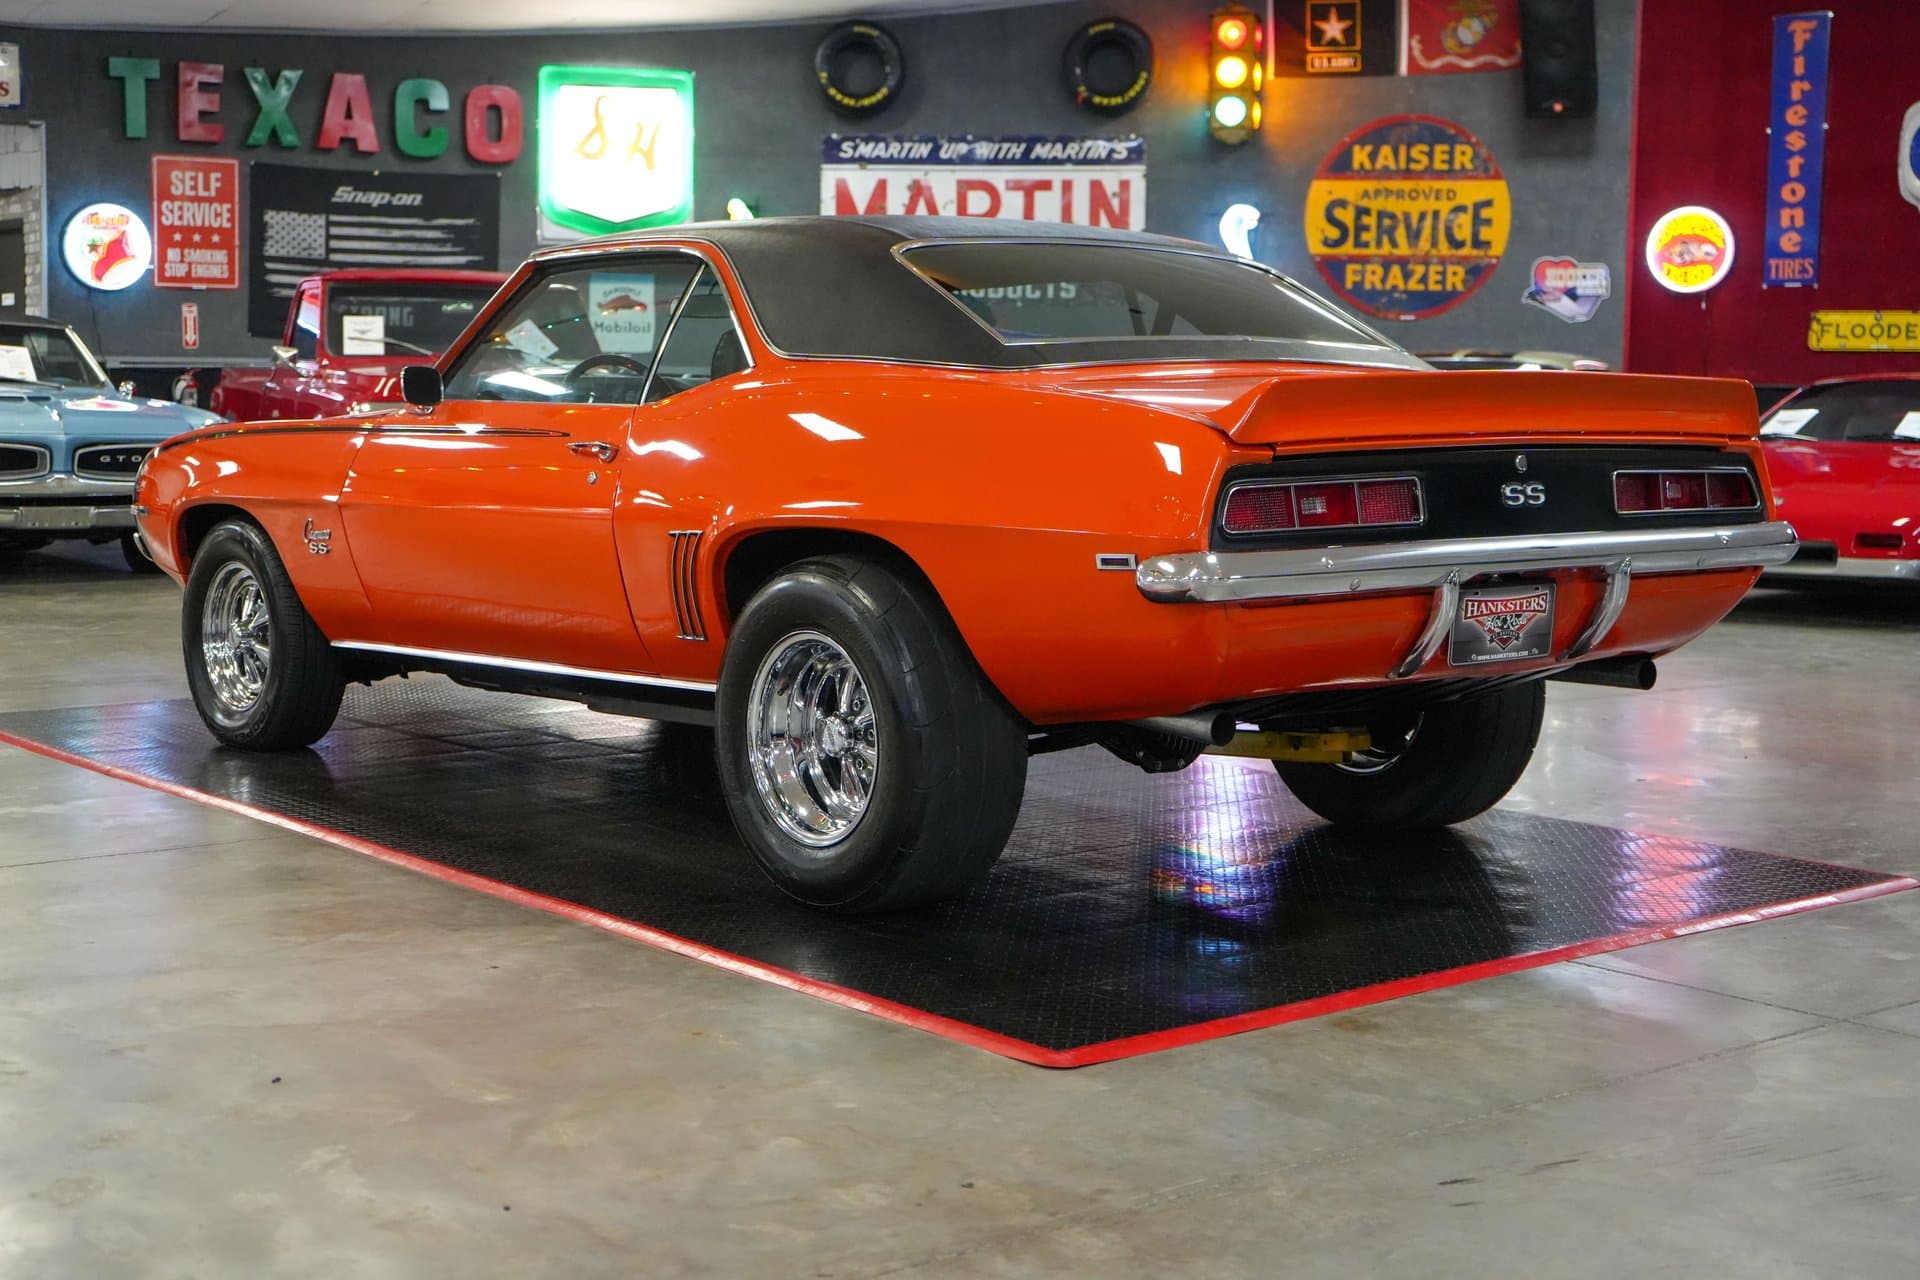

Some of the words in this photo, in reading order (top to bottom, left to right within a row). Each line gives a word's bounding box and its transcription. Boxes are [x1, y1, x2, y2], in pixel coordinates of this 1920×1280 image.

[108, 56, 523, 163] TEXACO
[1779, 20, 1818, 253] Firestone
[1351, 143, 1474, 171] KAISER
[170, 170, 222, 197] SELF
[1360, 187, 1457, 201] APPROVED
[331, 186, 424, 208] Snap-on
[161, 200, 232, 228] SERVICE
[1321, 197, 1495, 250] SERVICE
[167, 247, 181, 263] NO
[184, 248, 228, 264] SMOKING
[164, 263, 188, 278] STOP
[191, 264, 229, 279] ENGINES
[1344, 262, 1467, 292] FRAZER
[1768, 258, 1815, 280] TIRES
[594, 320, 651, 333] Mobiloil
[100, 455, 142, 463] GTO
[1502, 484, 1546, 506] SS
[309, 542, 328, 554] SS
[1467, 595, 1547, 617] HANKSTERS
[1484, 614, 1505, 631] Hot
